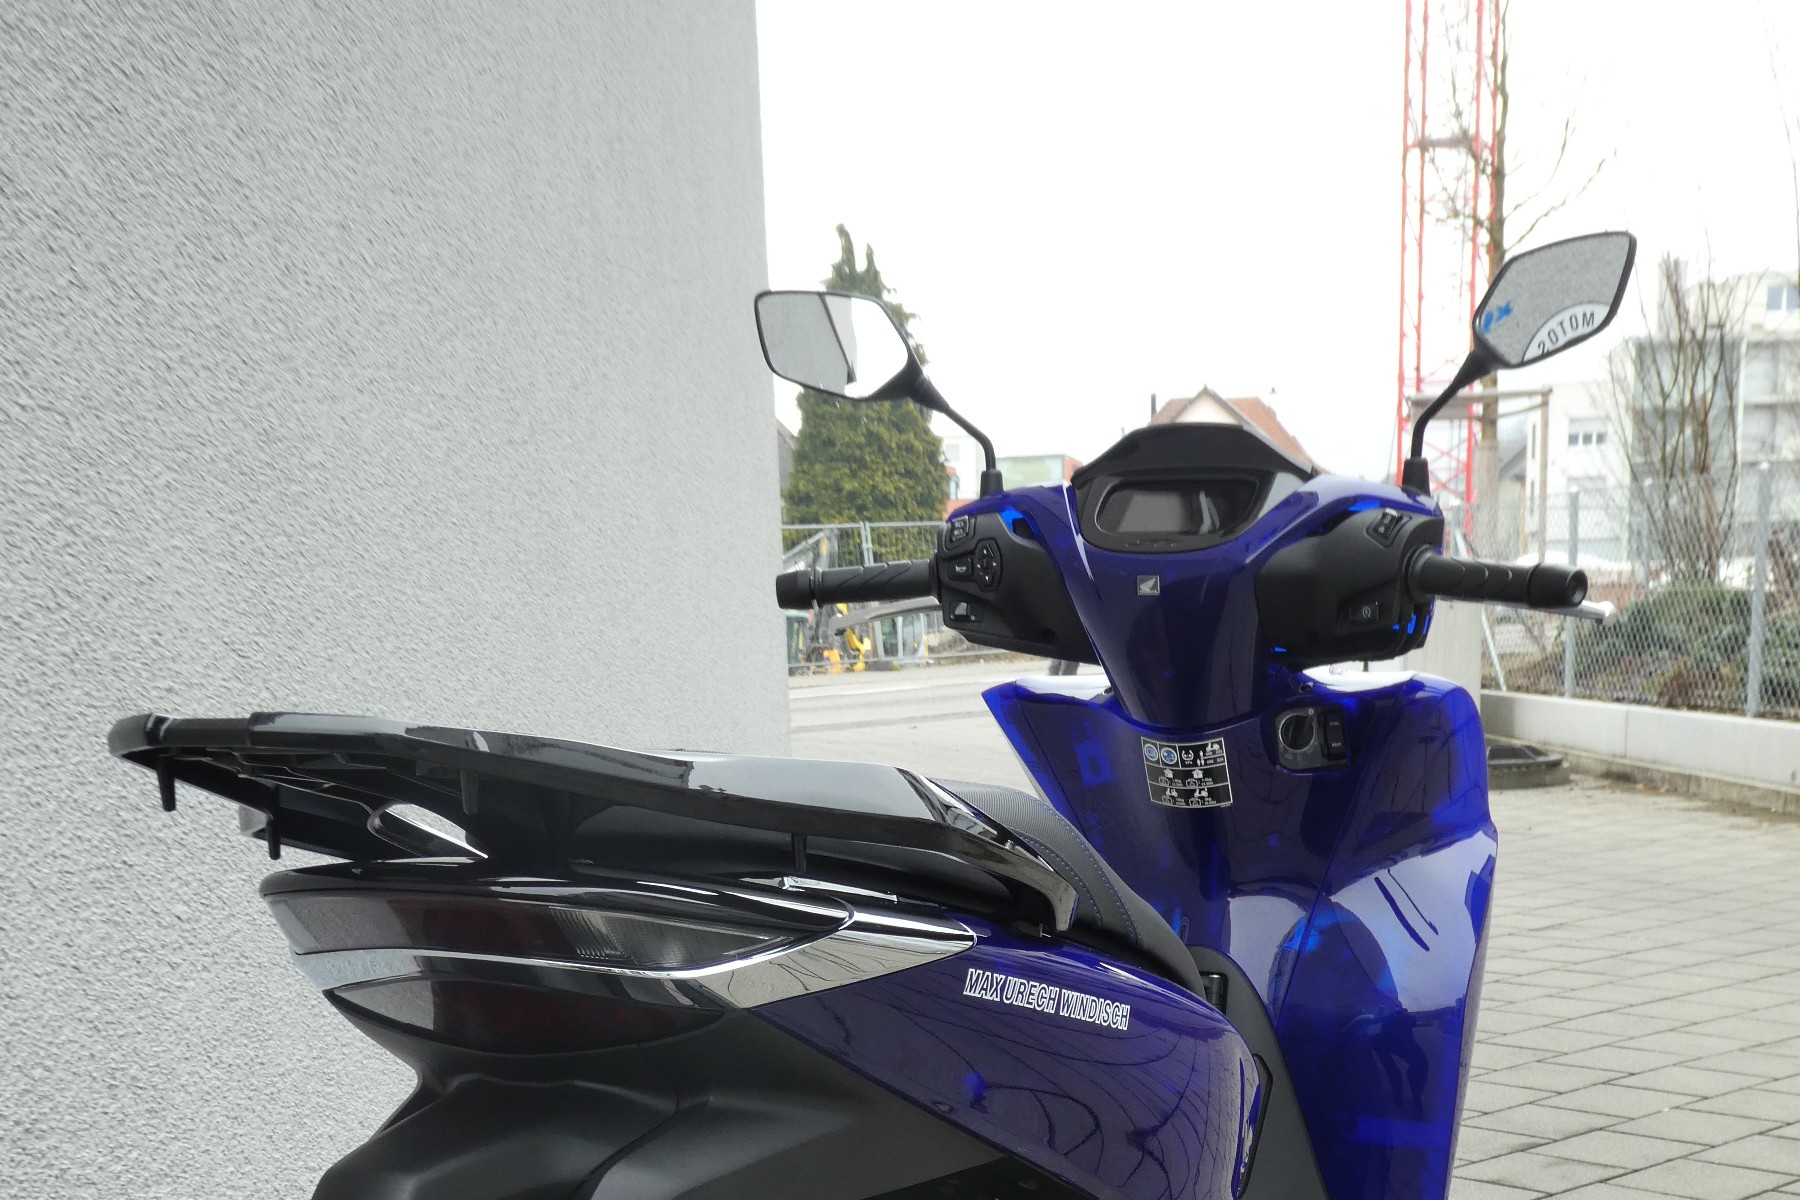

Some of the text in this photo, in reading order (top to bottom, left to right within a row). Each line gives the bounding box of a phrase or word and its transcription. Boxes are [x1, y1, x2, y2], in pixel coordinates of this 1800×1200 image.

[963, 968, 1131, 1031] MAX URECH WINDISCH
